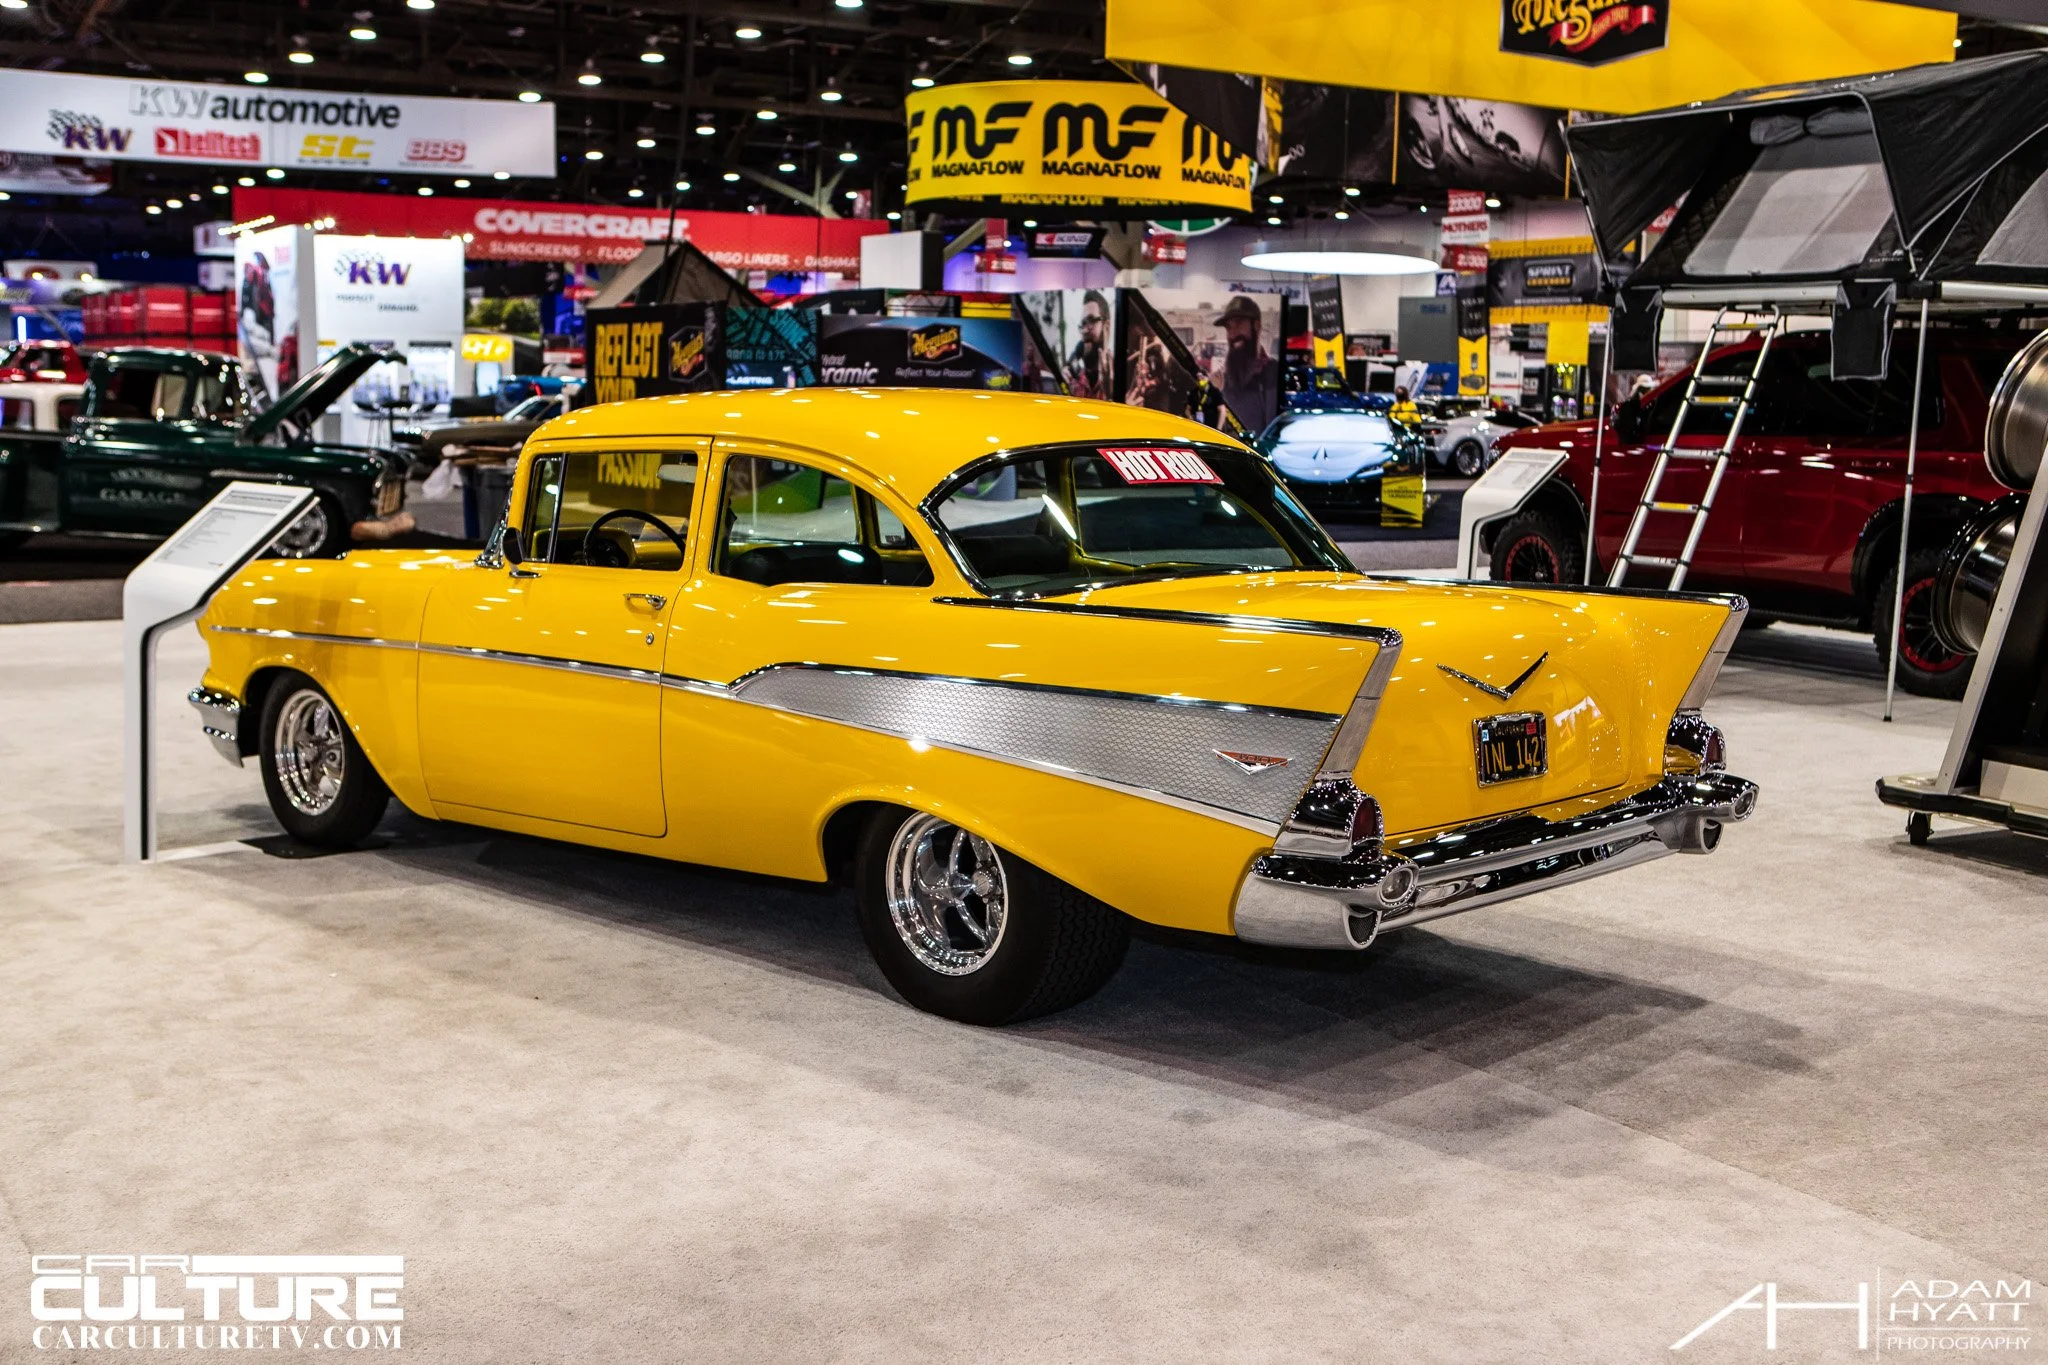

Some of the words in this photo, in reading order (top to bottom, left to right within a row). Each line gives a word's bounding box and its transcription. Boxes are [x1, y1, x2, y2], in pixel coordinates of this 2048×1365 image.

[64, 123, 132, 152] KW
[931, 160, 1026, 178] MAGNAFLOW
[1042, 160, 1162, 179] MAGNAFLOW
[474, 208, 690, 241] COVERCRAFT
[489, 241, 581, 258] SUNSCREENS
[707, 251, 742, 264] ARGO
[744, 253, 790, 267] LINERS
[804, 255, 860, 268] DASHMA
[349, 260, 412, 286] KW
[595, 321, 663, 378] REFLECT
[1105, 450, 1168, 481] HOT
[1152, 450, 1214, 481] ROD
[1517, 736, 1540, 770] 142
